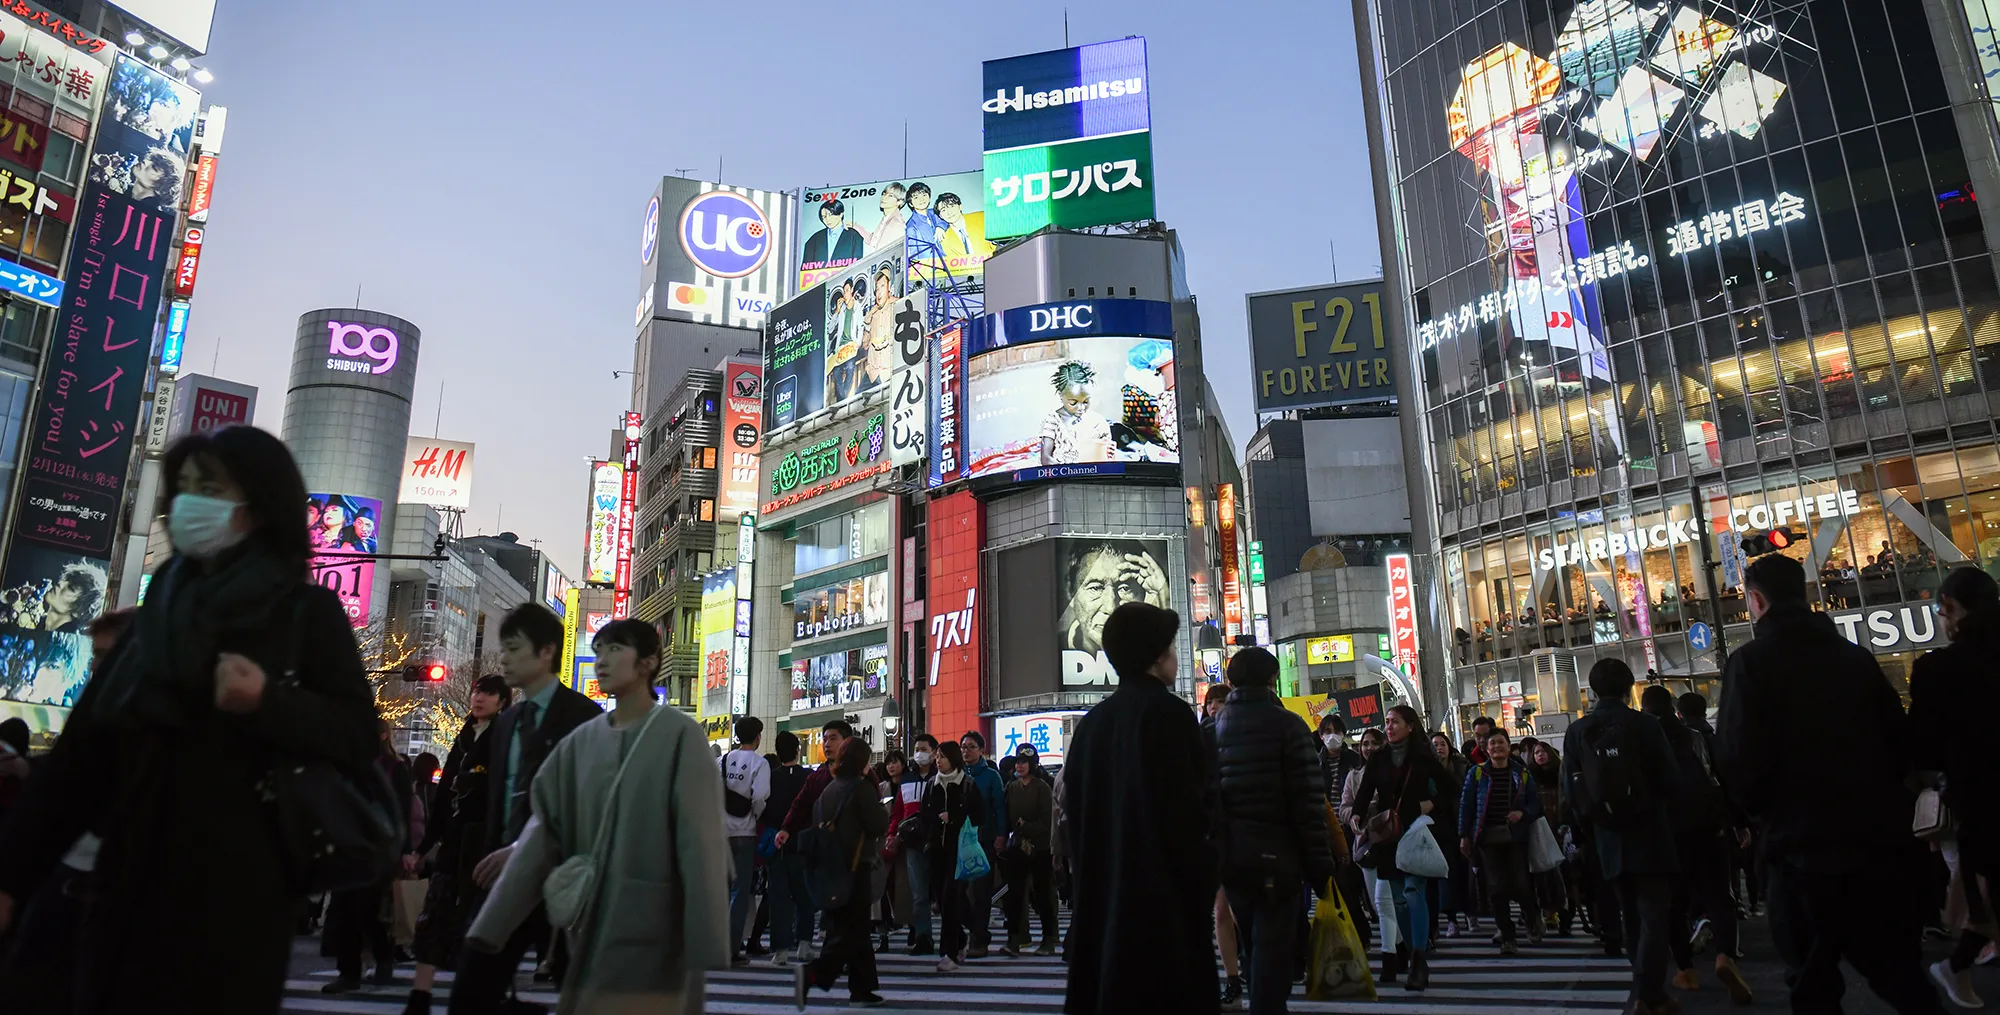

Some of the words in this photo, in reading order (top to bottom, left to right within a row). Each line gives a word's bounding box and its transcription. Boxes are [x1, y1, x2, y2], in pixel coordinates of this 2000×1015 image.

[982, 78, 1142, 114] Hisamitsu
[804, 191, 839, 204] Sexy
[841, 187, 877, 200] Zone
[991, 159, 1143, 208] サロンパス
[99, 193, 110, 210] 1st
[89, 213, 104, 247] single
[1666, 192, 1806, 258] 通常国会
[0, 266, 59, 297] ーオン
[180, 256, 197, 288] ガスト
[802, 261, 825, 271] NEW
[75, 295, 88, 308] a
[736, 298, 772, 313] VISA
[1030, 305, 1093, 332] DHC
[1292, 292, 1385, 358] F21
[64, 314, 88, 363] slave
[327, 321, 399, 374] 109
[327, 359, 371, 374] SHIBUYA
[893, 299, 925, 456] もんじゃ
[1262, 358, 1391, 398] FOREVER
[56, 369, 78, 399] for
[777, 390, 792, 404] Uber
[150, 386, 170, 446] 渋谷駅前ビル
[201, 395, 238, 418] UNI
[776, 402, 792, 415] Eats
[939, 336, 955, 474] 三千里薬品
[411, 446, 467, 481] H&M
[801, 447, 839, 485] 西村
[1038, 467, 1059, 478] DHC
[1060, 465, 1098, 477] Channel
[1540, 516, 1709, 571] STARBUCKS
[1727, 490, 1861, 532] COFFEE
[797, 612, 860, 637] Euphoria
[930, 588, 976, 686] クスリ
[563, 641, 572, 683] Matsumoto
[1004, 723, 1063, 756] 大盛
